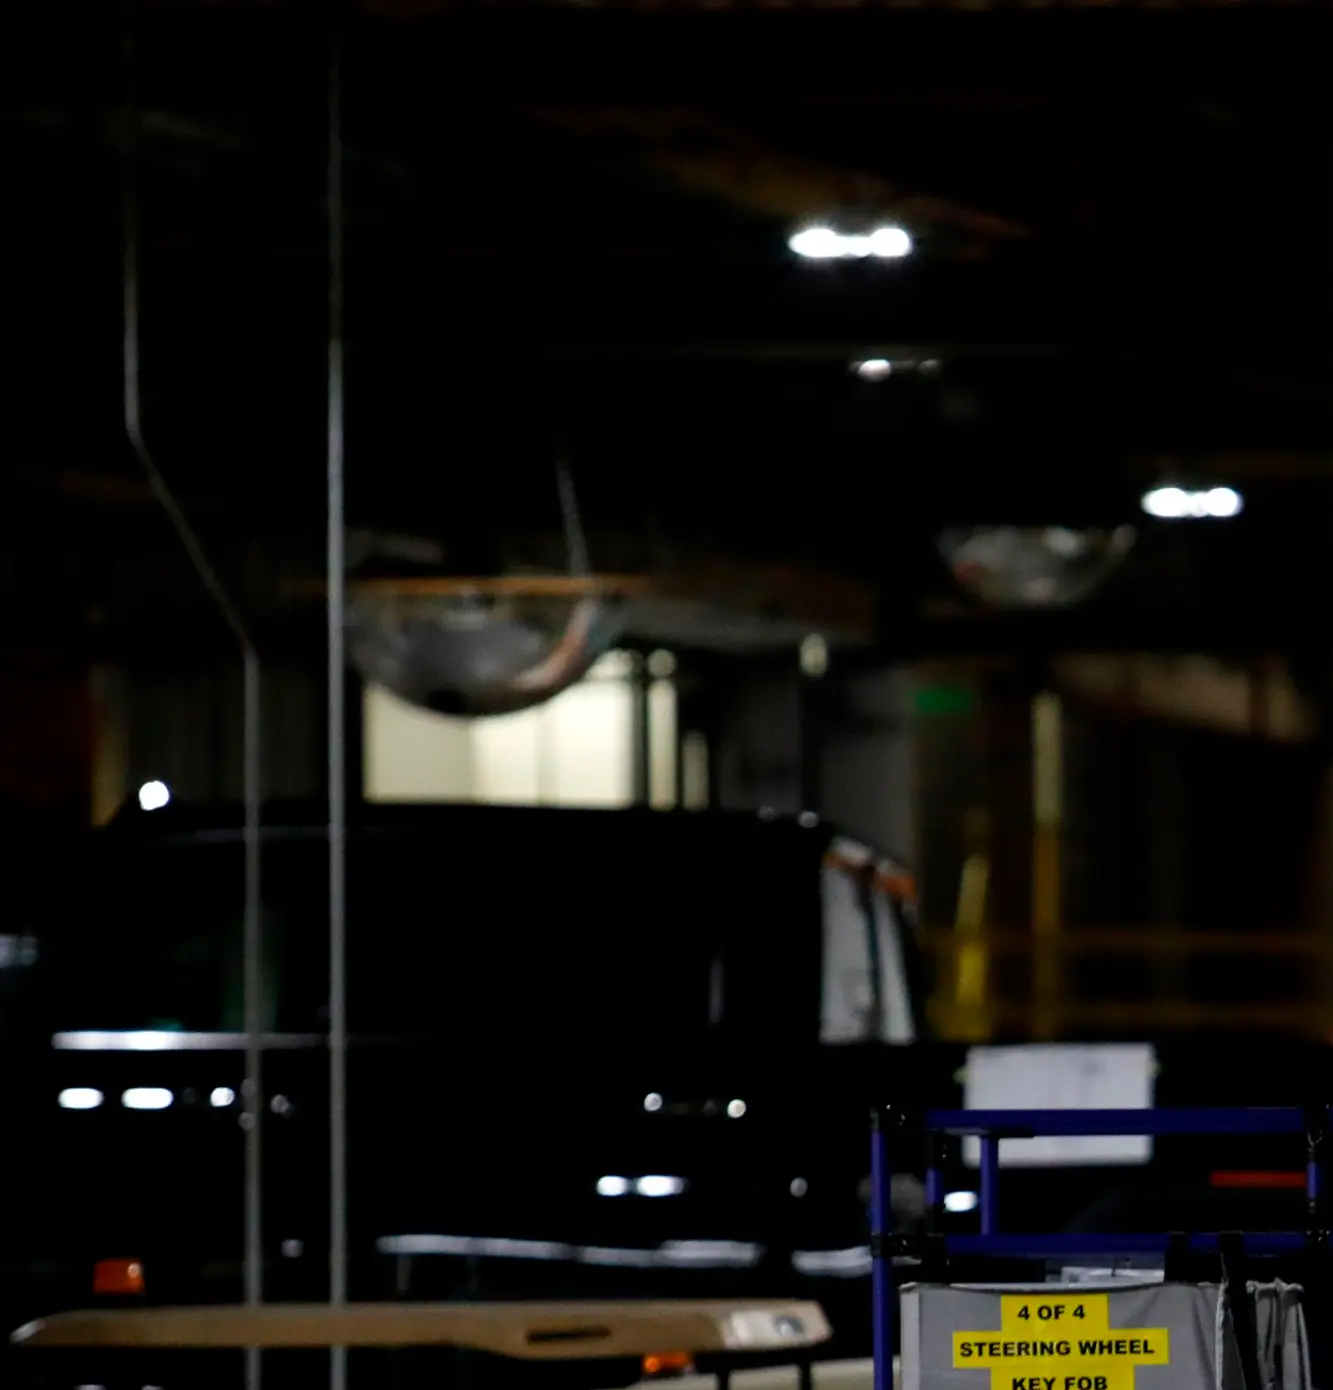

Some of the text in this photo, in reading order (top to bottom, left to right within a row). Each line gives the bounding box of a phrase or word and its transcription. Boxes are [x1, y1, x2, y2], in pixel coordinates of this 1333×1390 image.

[1017, 1304, 1086, 1320] 4 OF 4
[960, 1338, 1155, 1358] STEERING WHEEL
[1064, 1376, 1108, 1390] FOB
